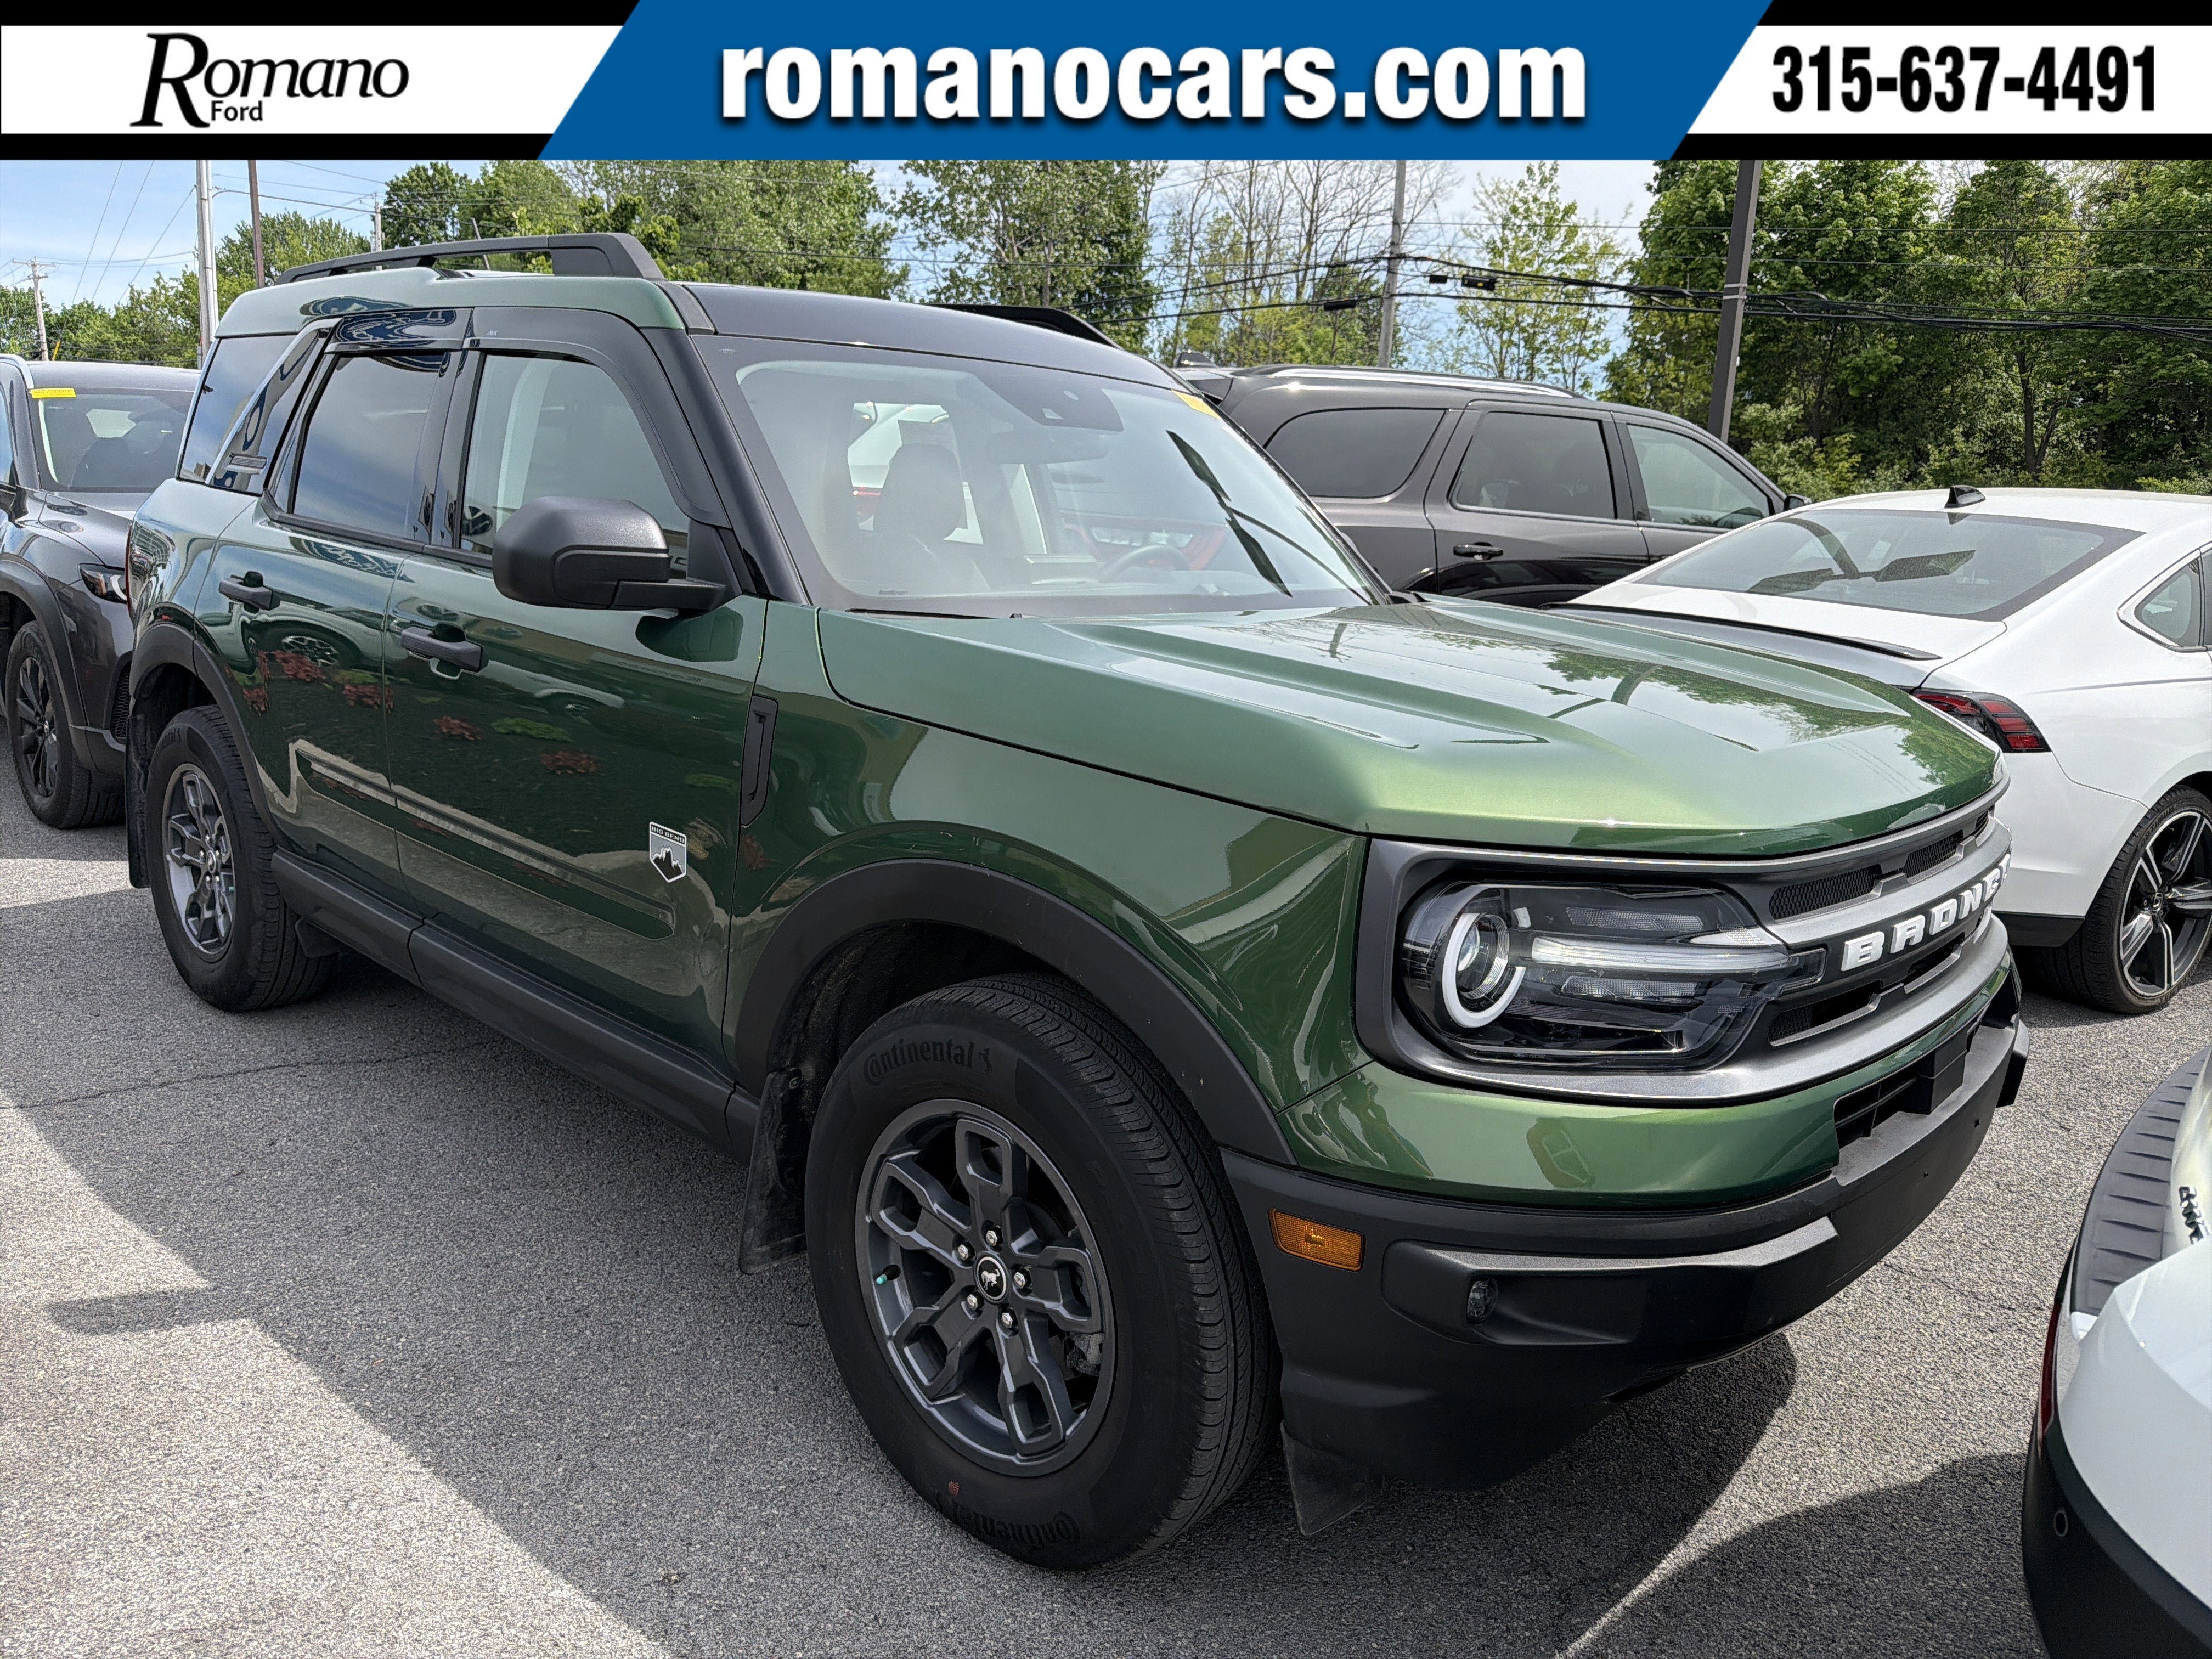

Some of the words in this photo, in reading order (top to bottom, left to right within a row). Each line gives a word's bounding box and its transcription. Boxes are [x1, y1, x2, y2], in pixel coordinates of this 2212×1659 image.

[651, 826, 664, 836] BIG
[664, 831, 685, 843] BEND
[863, 1038, 976, 1087] Continental
